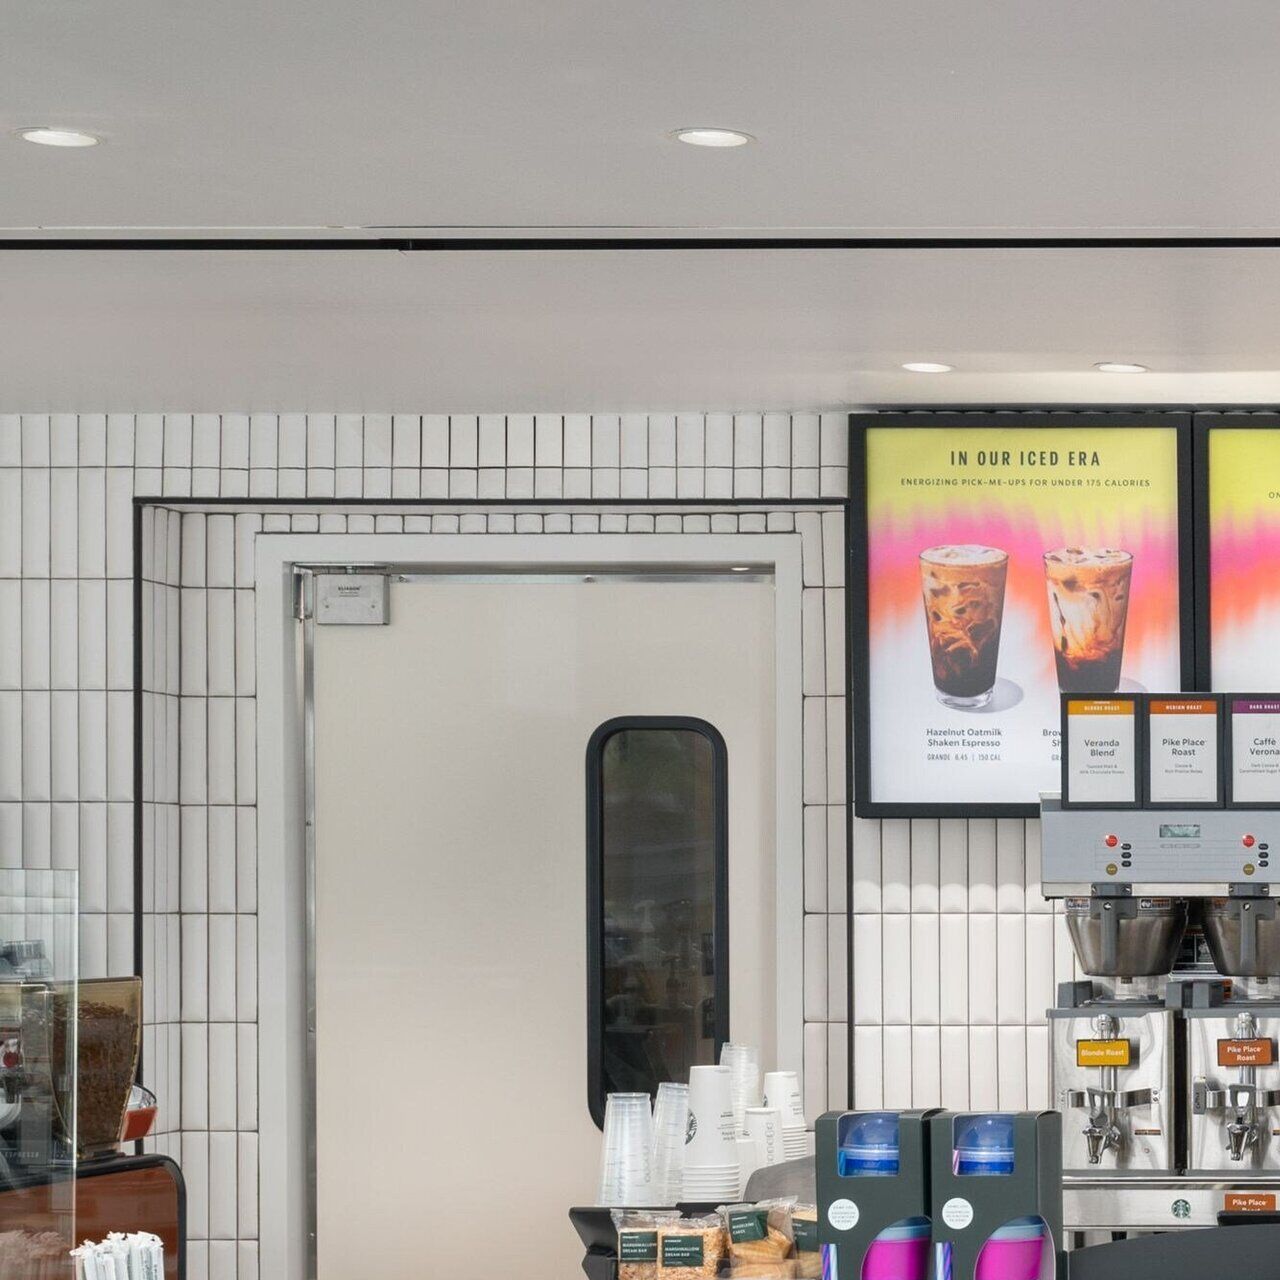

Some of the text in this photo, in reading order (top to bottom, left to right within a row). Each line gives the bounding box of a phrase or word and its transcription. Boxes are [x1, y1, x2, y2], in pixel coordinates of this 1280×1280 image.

[951, 450, 1100, 466] IN OUR ICED ERA
[901, 478, 1150, 487] ENERGIZING PICK-ME-UPS FOR UNDER 175 CALORIES
[926, 728, 1002, 737] Hazelnut Oatmilk
[927, 739, 1000, 748] Shaken Espresso
[1084, 739, 1120, 748] Veranda
[1162, 738, 1204, 746] Pike Place
[1253, 738, 1276, 746] Caffè
[1090, 748, 1114, 757] Blend
[1172, 748, 1196, 756] Roast
[1250, 748, 1280, 756] Verona
[1227, 1046, 1240, 1054] Pike
[1236, 1054, 1256, 1062] Roast
